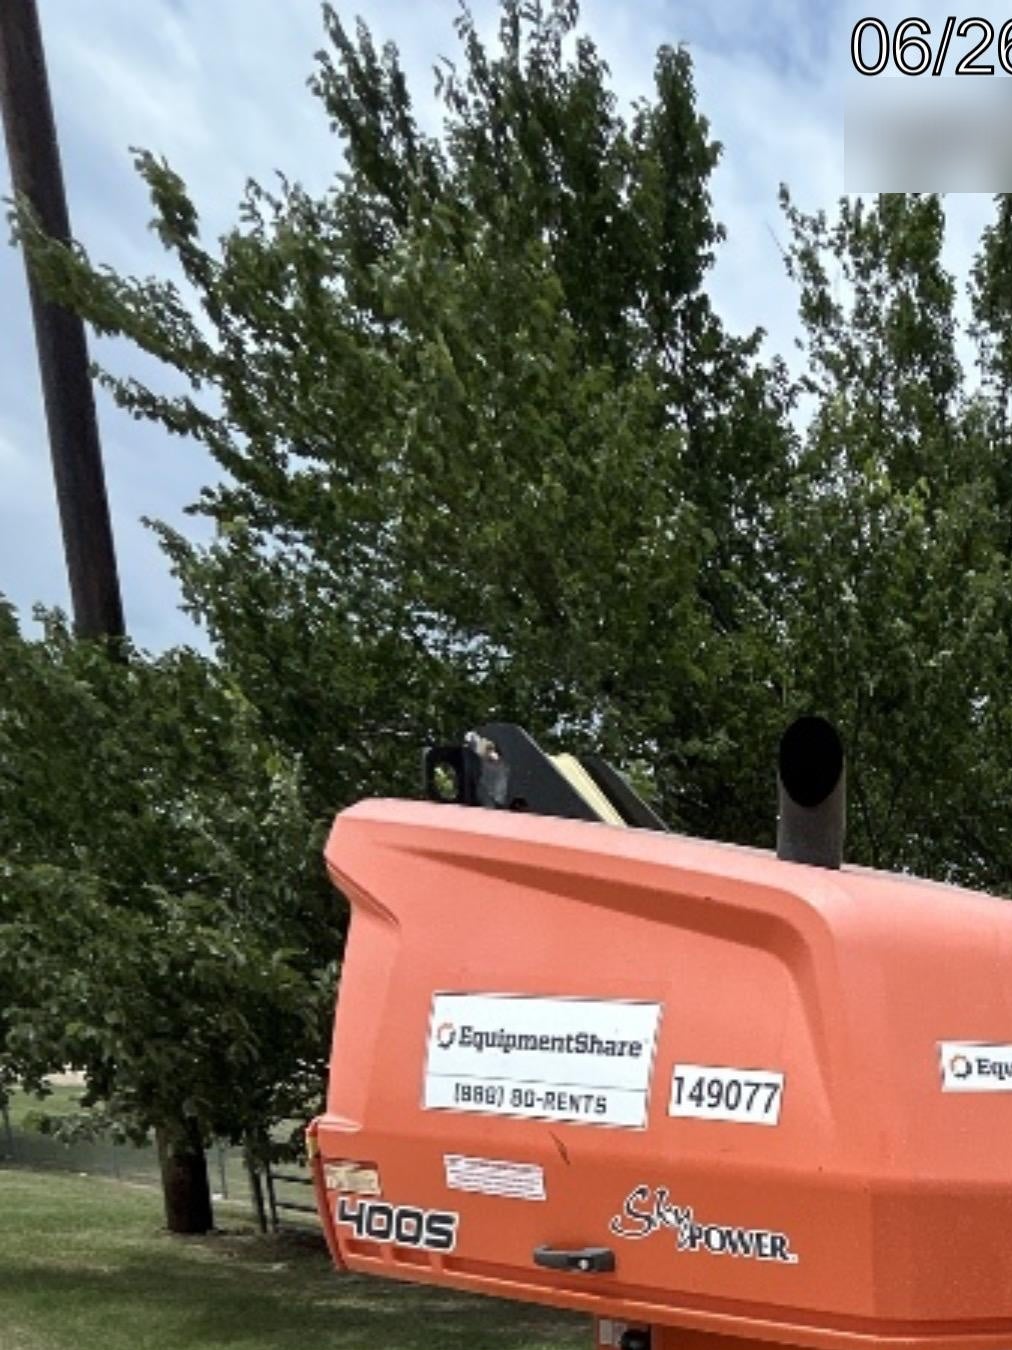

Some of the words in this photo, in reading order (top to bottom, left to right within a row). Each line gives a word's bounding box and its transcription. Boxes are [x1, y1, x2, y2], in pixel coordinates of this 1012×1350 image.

[458, 1025, 643, 1058] EquipmentShare
[674, 1076, 780, 1114] 149077
[337, 1198, 458, 1252] 400S
